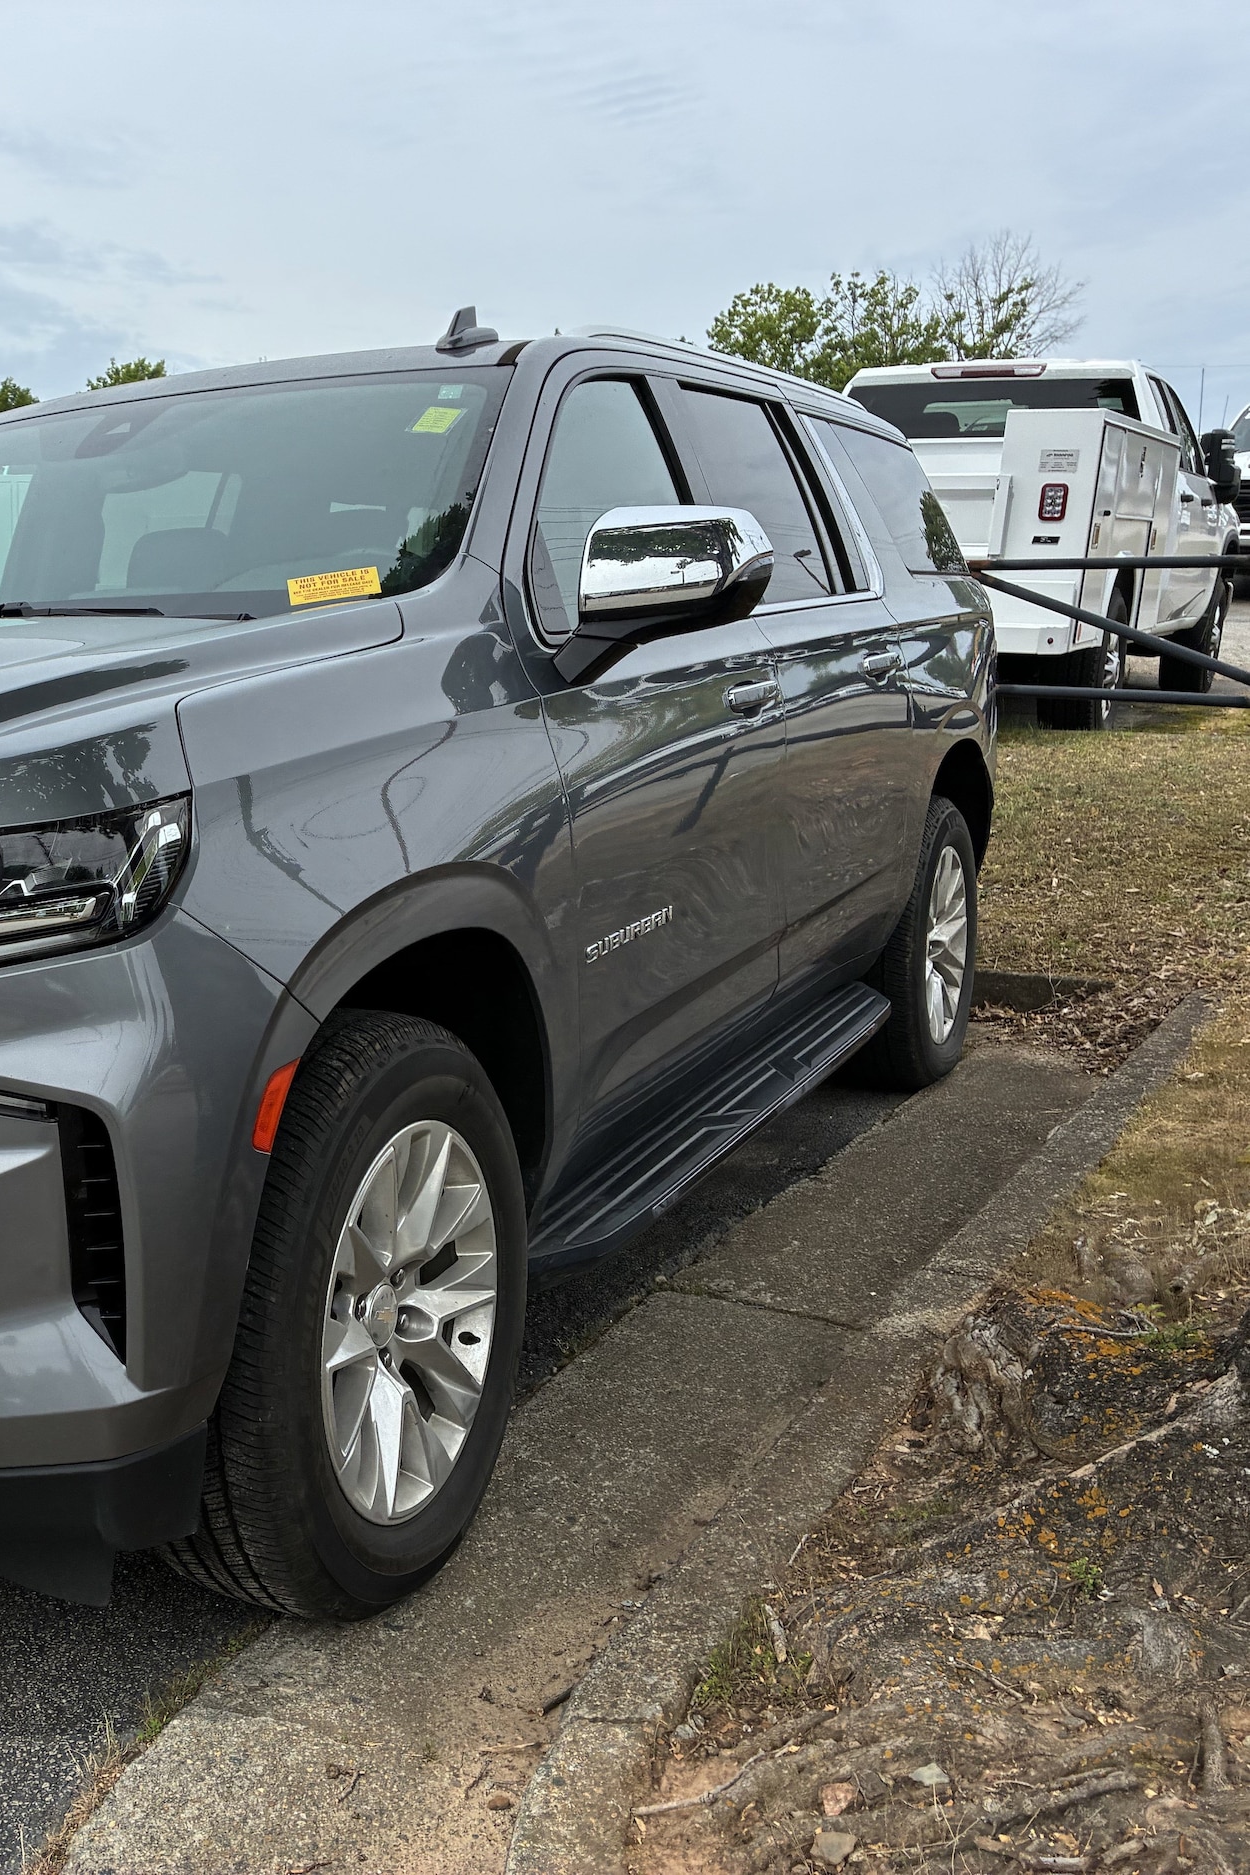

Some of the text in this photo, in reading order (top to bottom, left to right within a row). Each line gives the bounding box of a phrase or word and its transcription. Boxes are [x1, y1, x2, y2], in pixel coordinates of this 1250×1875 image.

[318, 570, 357, 581] VEHICLE
[342, 575, 366, 583] SALE
[585, 905, 673, 964] SUBURBAN
